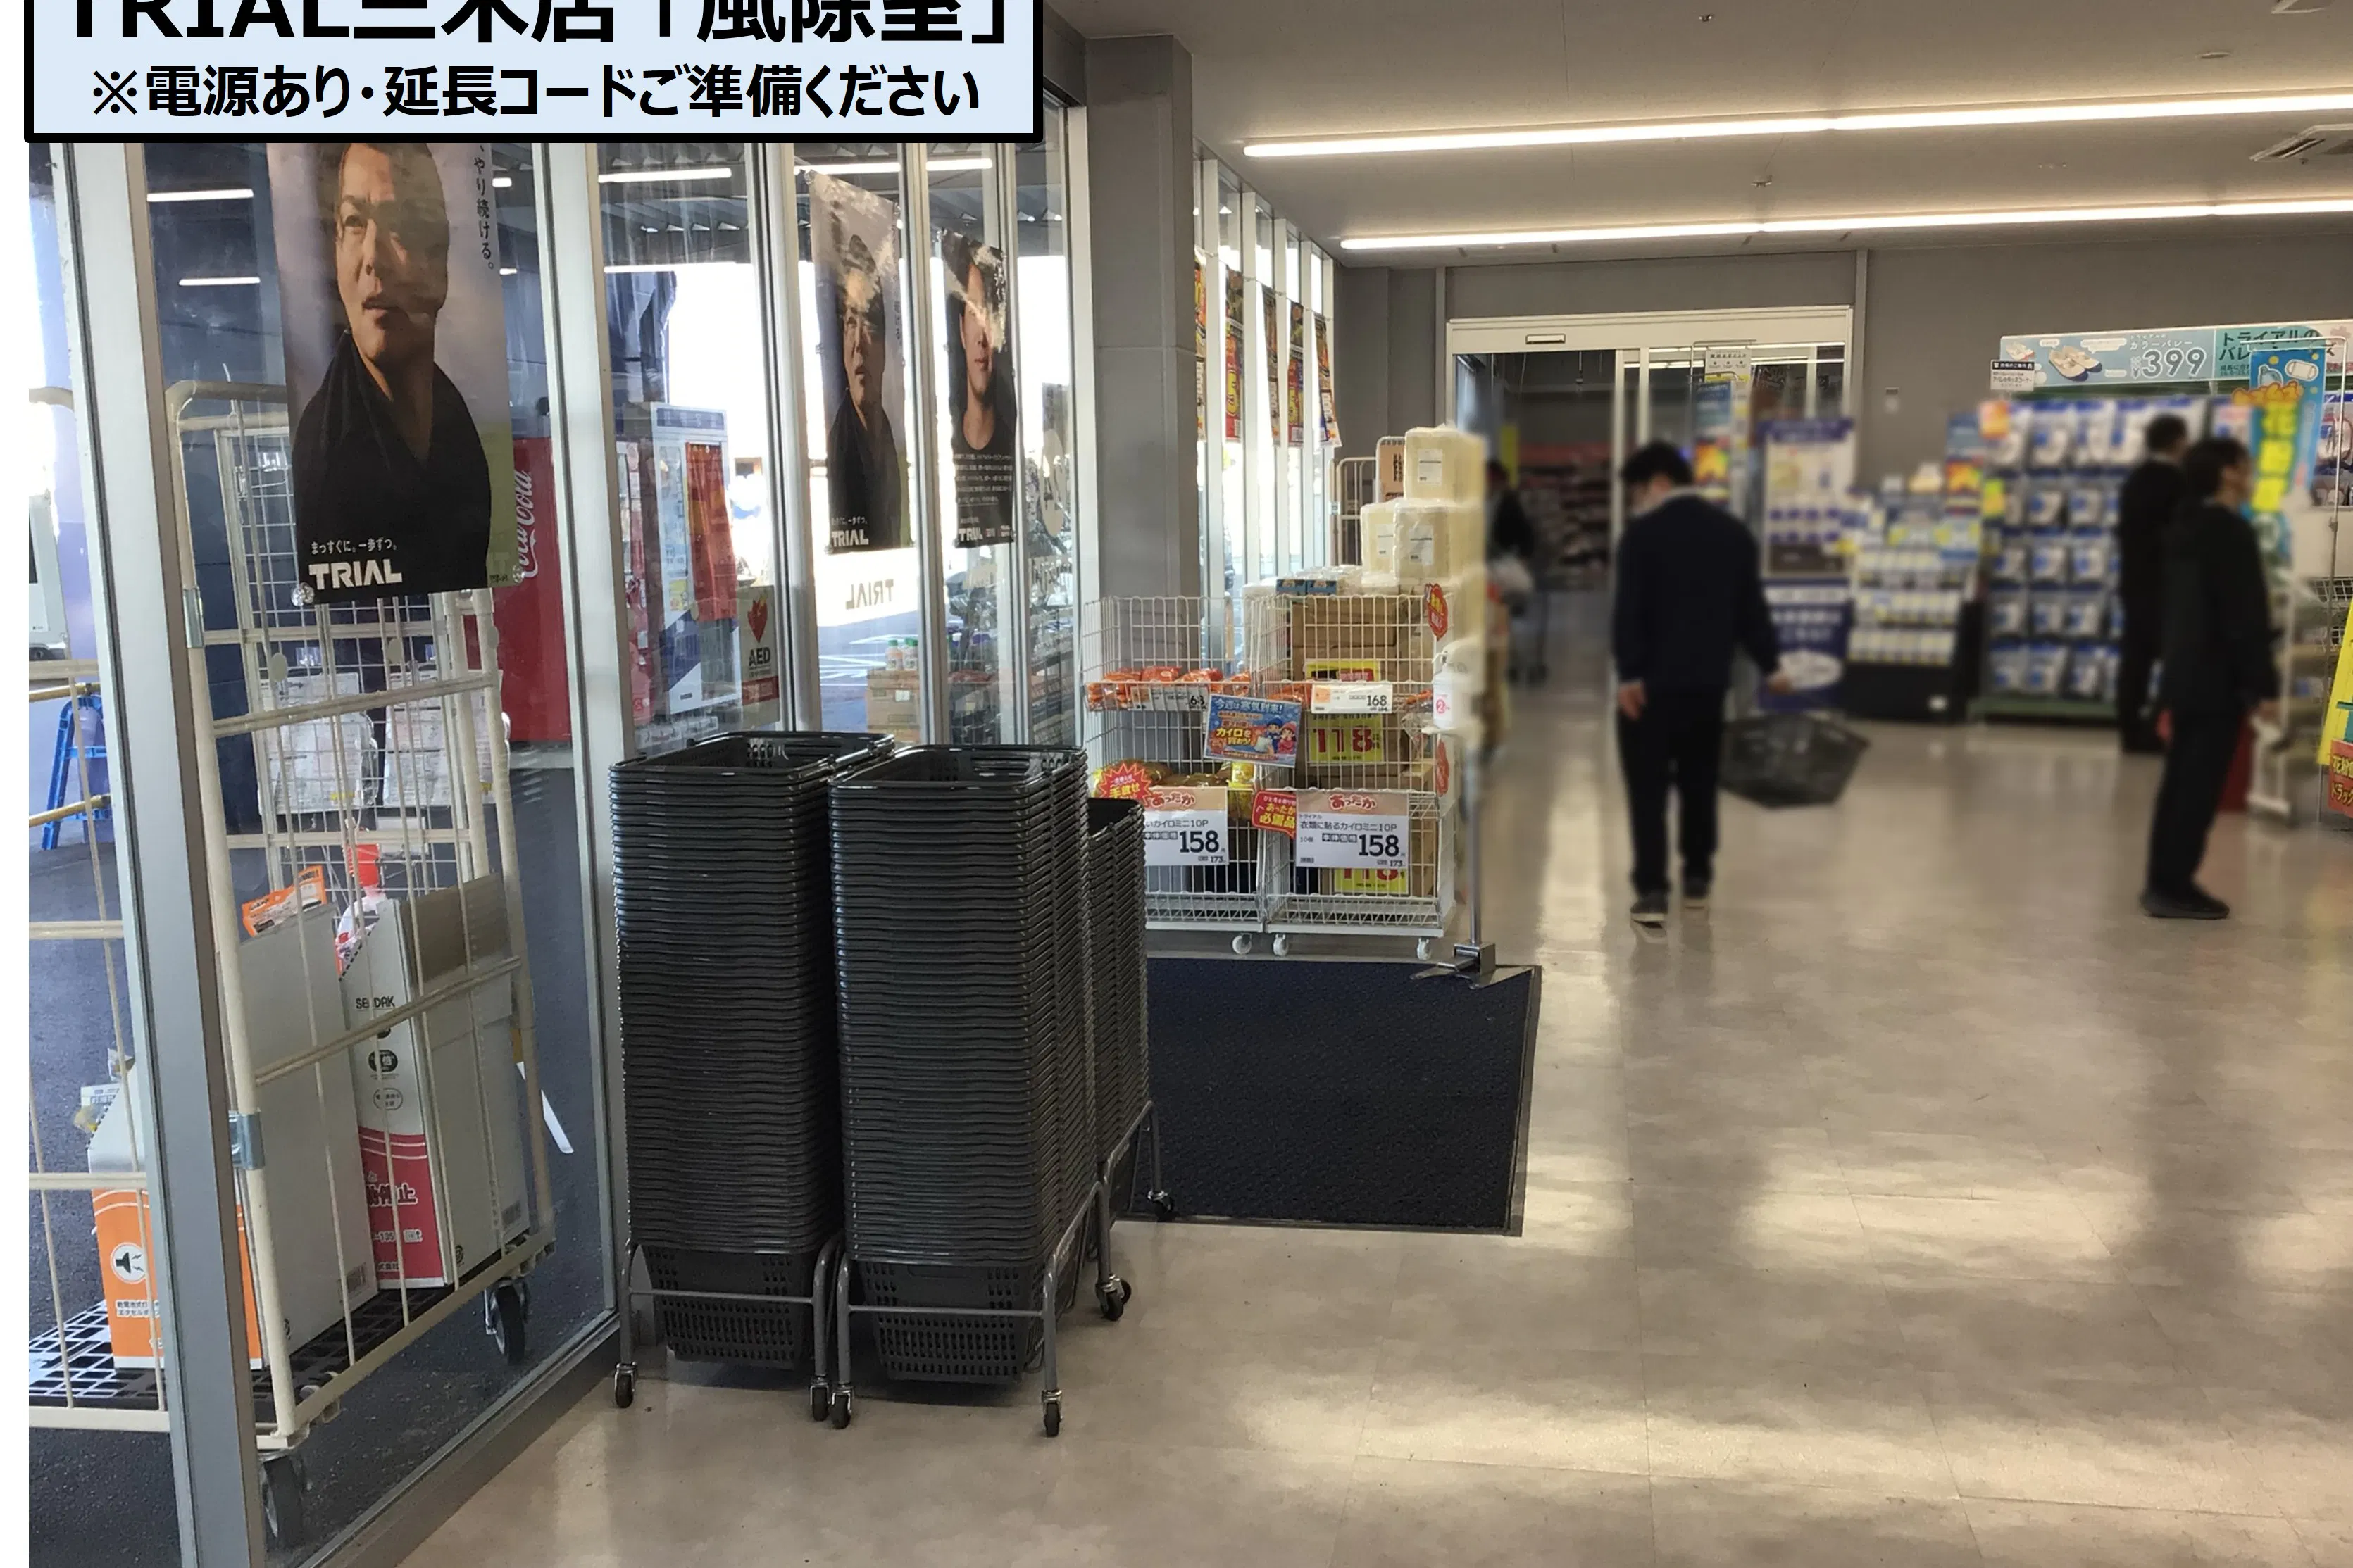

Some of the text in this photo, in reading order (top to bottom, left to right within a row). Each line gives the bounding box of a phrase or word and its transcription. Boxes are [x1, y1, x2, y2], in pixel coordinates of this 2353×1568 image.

[2142, 346, 2207, 379] 399
[831, 529, 869, 547] TRIAL
[308, 558, 403, 590] TRIAL
[749, 646, 771, 667] AED
[1366, 695, 1387, 707] 168
[1151, 791, 1196, 808] あったか
[1329, 794, 1376, 810] あったか
[1180, 830, 1220, 853] 158
[1359, 834, 1399, 857] 158
